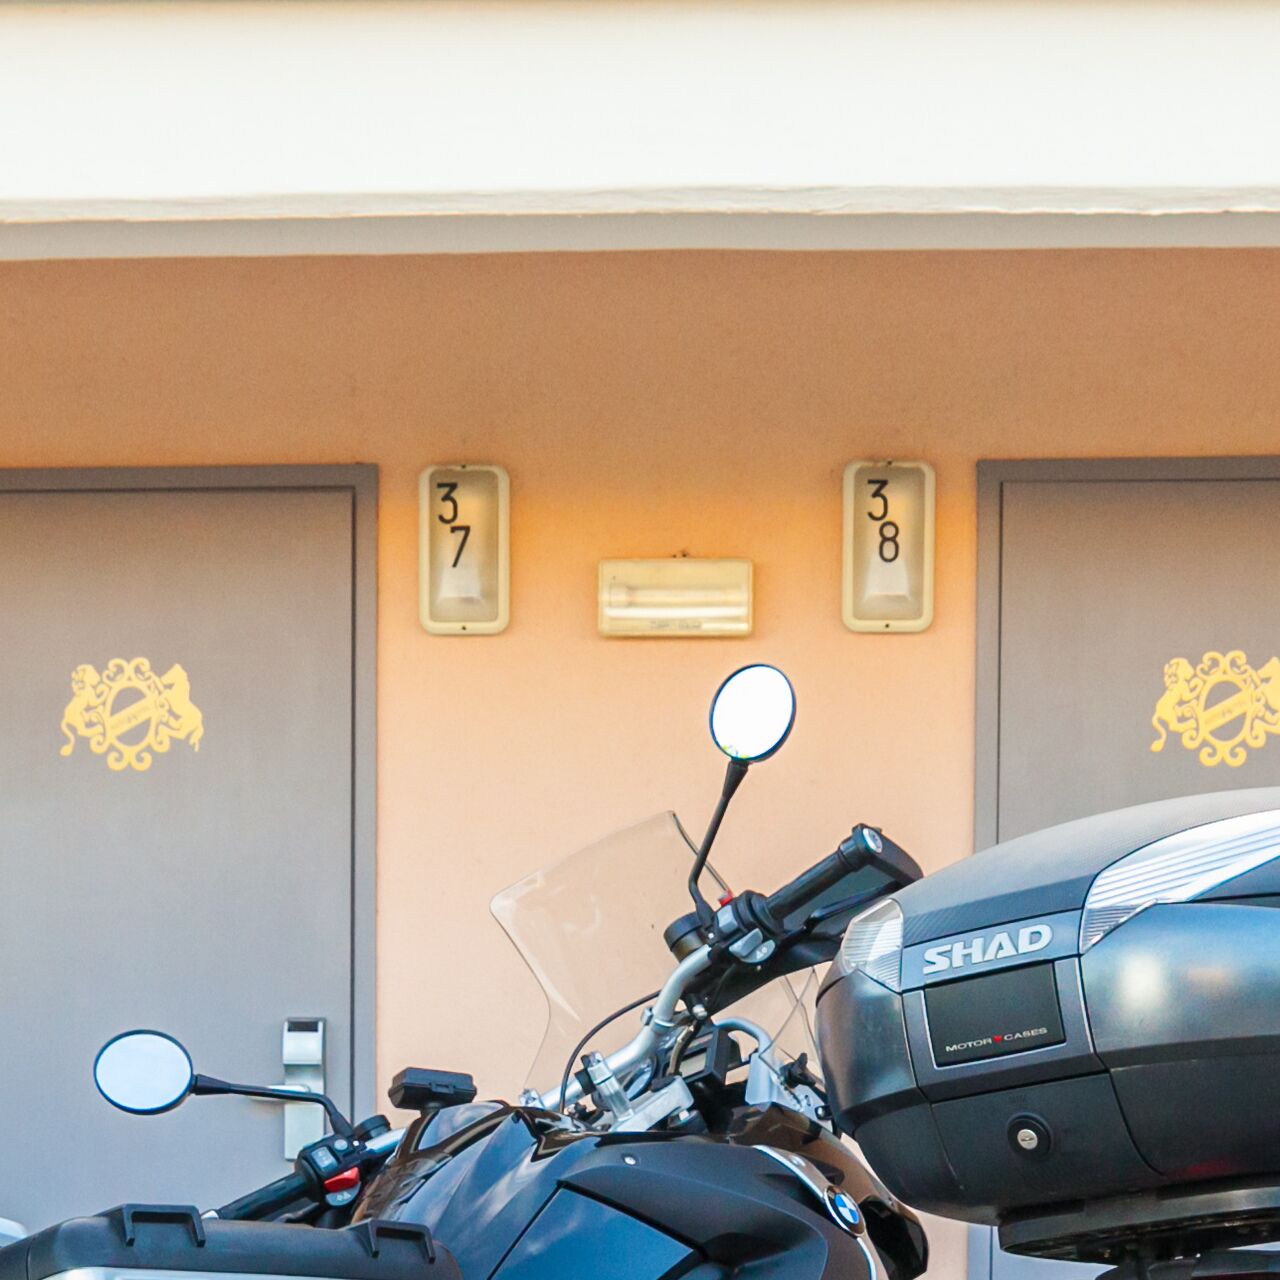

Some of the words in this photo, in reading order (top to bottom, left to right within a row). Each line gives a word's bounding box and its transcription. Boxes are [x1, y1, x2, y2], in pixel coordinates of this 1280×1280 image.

[436, 482, 471, 568] 37
[867, 479, 900, 563] 38
[923, 924, 1053, 975] SHAD
[945, 1038, 993, 1052] MOTOR
[1003, 1027, 1048, 1041] CASES
